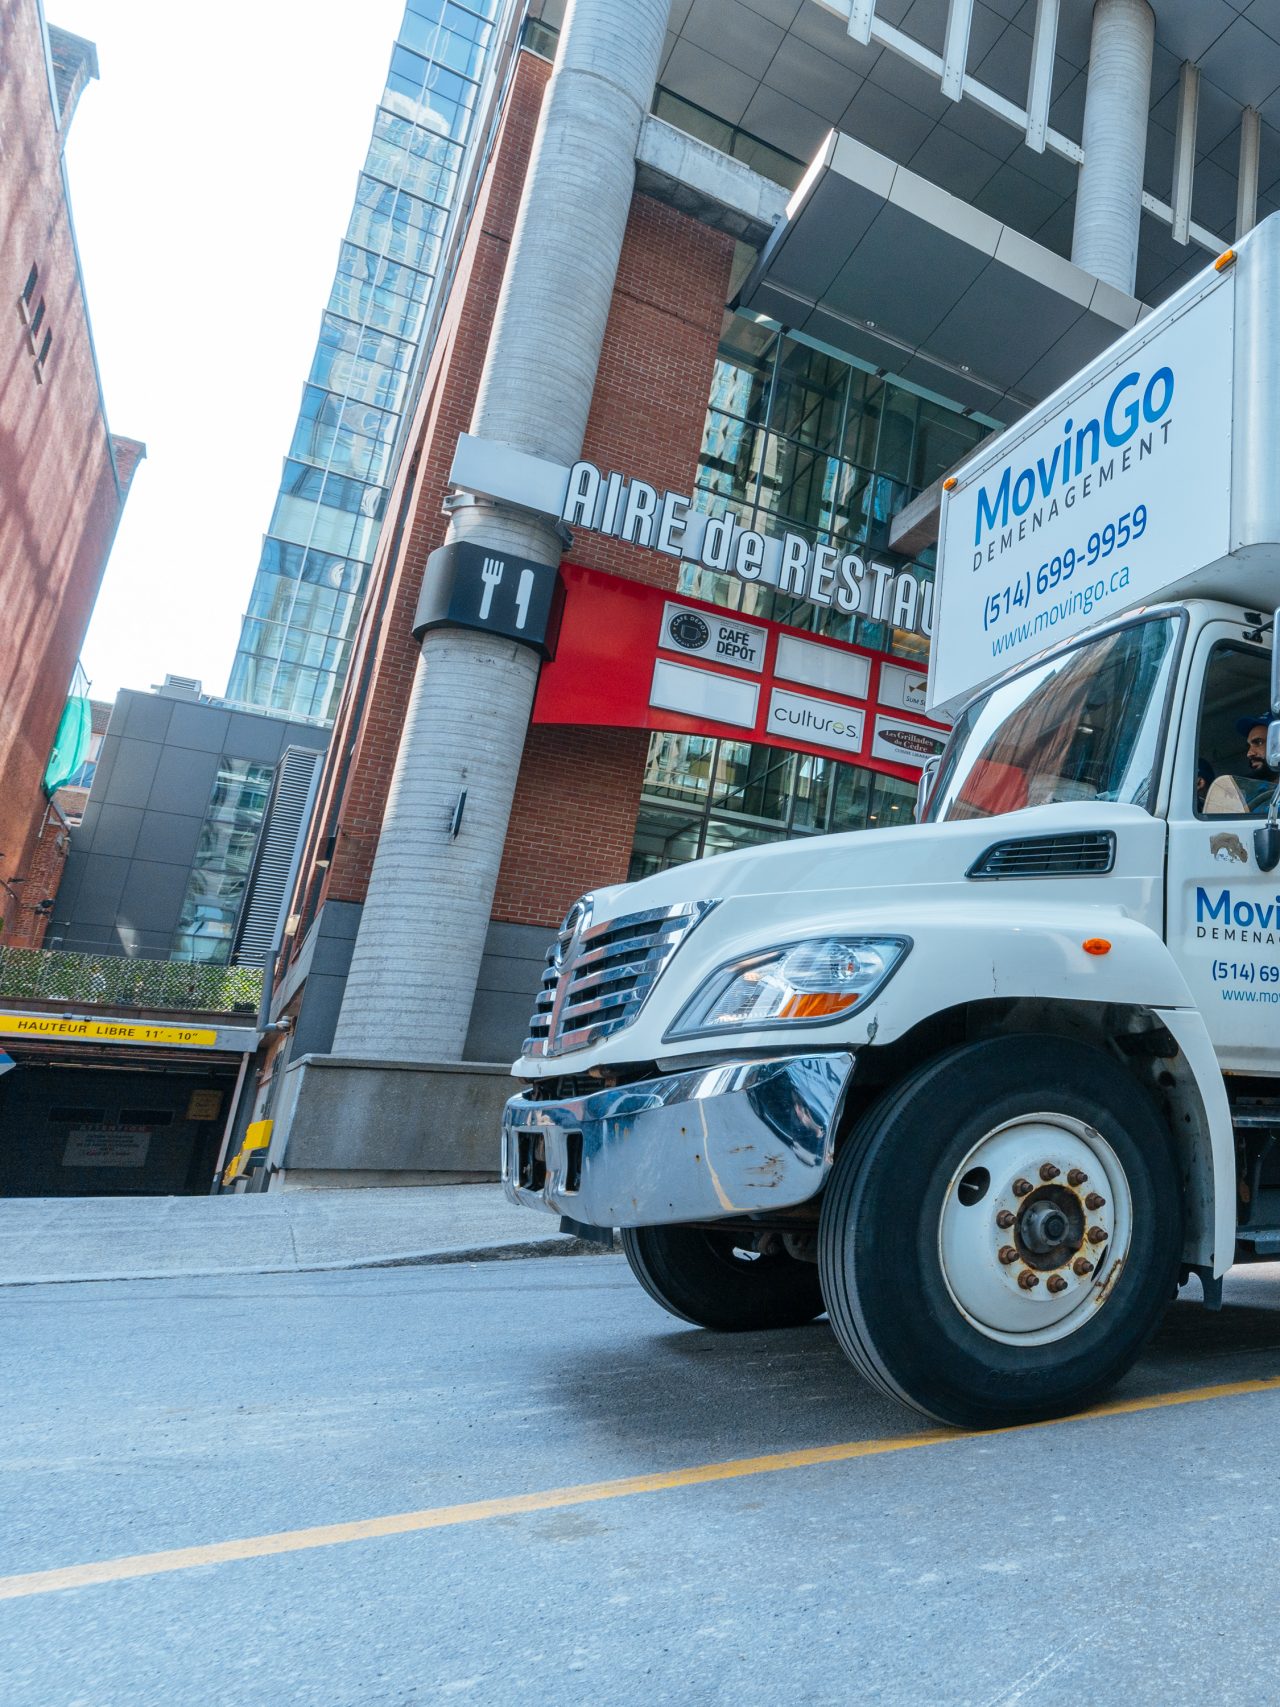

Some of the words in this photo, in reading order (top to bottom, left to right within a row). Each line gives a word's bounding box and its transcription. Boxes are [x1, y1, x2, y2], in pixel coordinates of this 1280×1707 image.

[974, 366, 1175, 548] MovinGo
[561, 460, 692, 558] AIRE
[700, 510, 766, 581] de
[972, 419, 1173, 573] DEMENAGEMENT
[983, 571, 1031, 631] (514)
[1036, 503, 1148, 595] 699-9959
[719, 627, 750, 647] CAFÉ
[991, 565, 1131, 657] www.movingo.ca
[716, 640, 756, 661] DÉPÔT
[897, 731, 934, 747] Grillades
[1211, 959, 1255, 984] (514)
[17, 1020, 89, 1034] HAUTEUR
[96, 1026, 136, 1038] LIBRE
[145, 1030, 164, 1039] 11'
